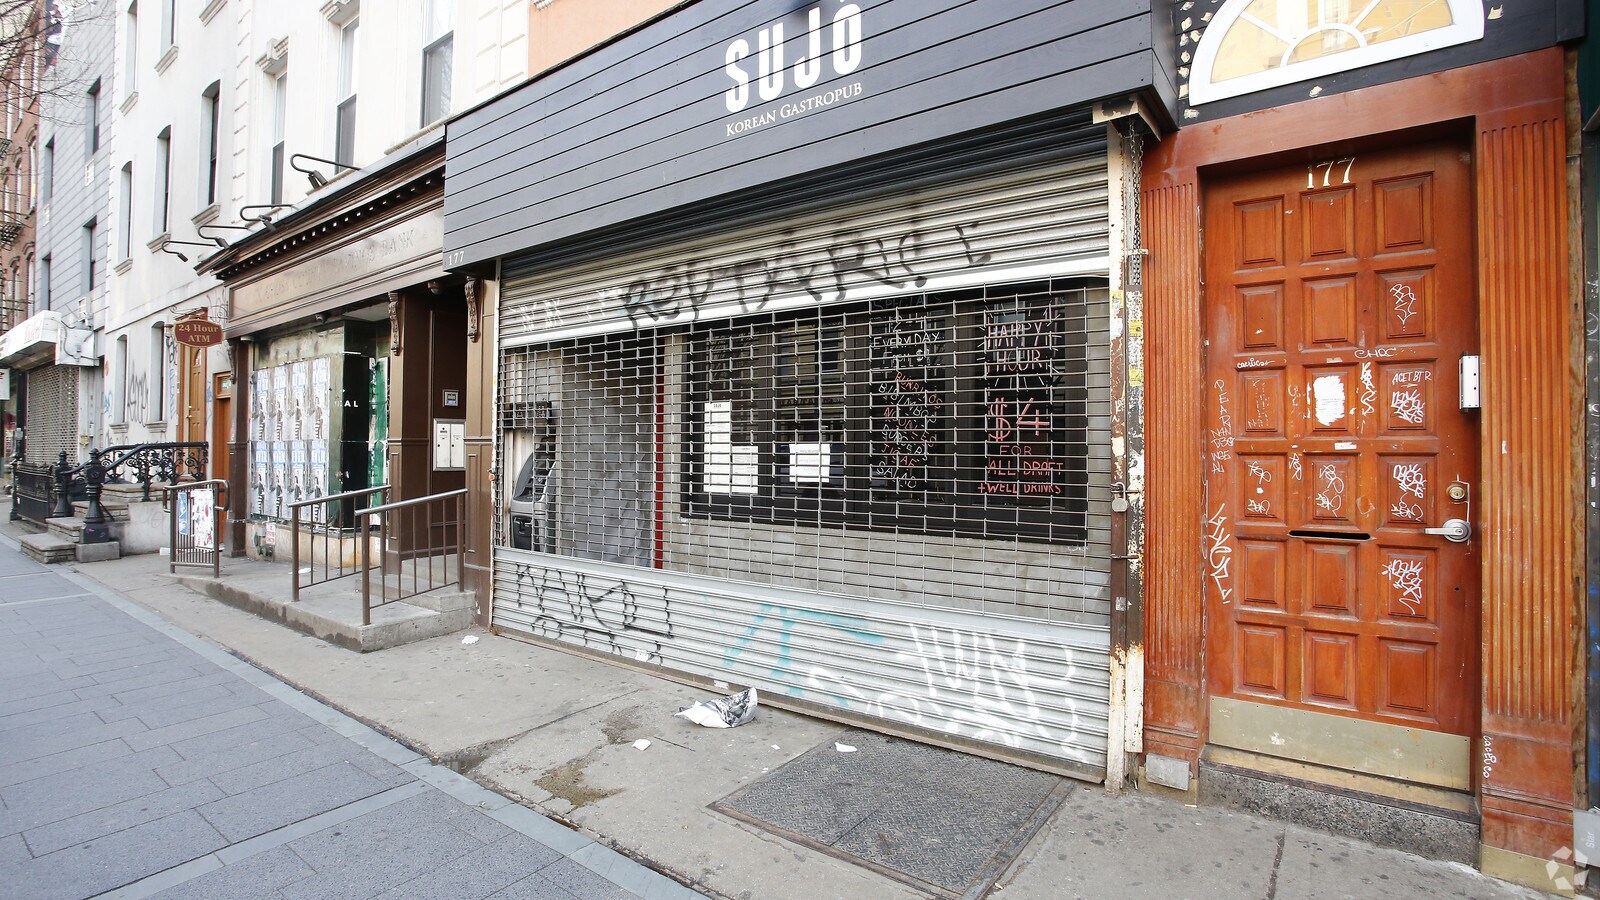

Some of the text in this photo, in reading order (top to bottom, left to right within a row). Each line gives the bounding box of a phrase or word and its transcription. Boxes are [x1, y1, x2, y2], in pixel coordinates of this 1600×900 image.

[726, 83, 862, 136] KOREAN GASTROPUB
[1307, 157, 1356, 189] 177
[448, 250, 465, 266] 177
[178, 324, 219, 333] 24 Hour
[987, 321, 1043, 349] HAPPY
[188, 334, 210, 343] ATM
[996, 349, 1043, 372] HOUR
[988, 396, 1051, 442] $4
[999, 444, 1032, 456] FOR
[987, 460, 1064, 476] ALL DRAFT
[1023, 482, 1062, 495] DRINKS
